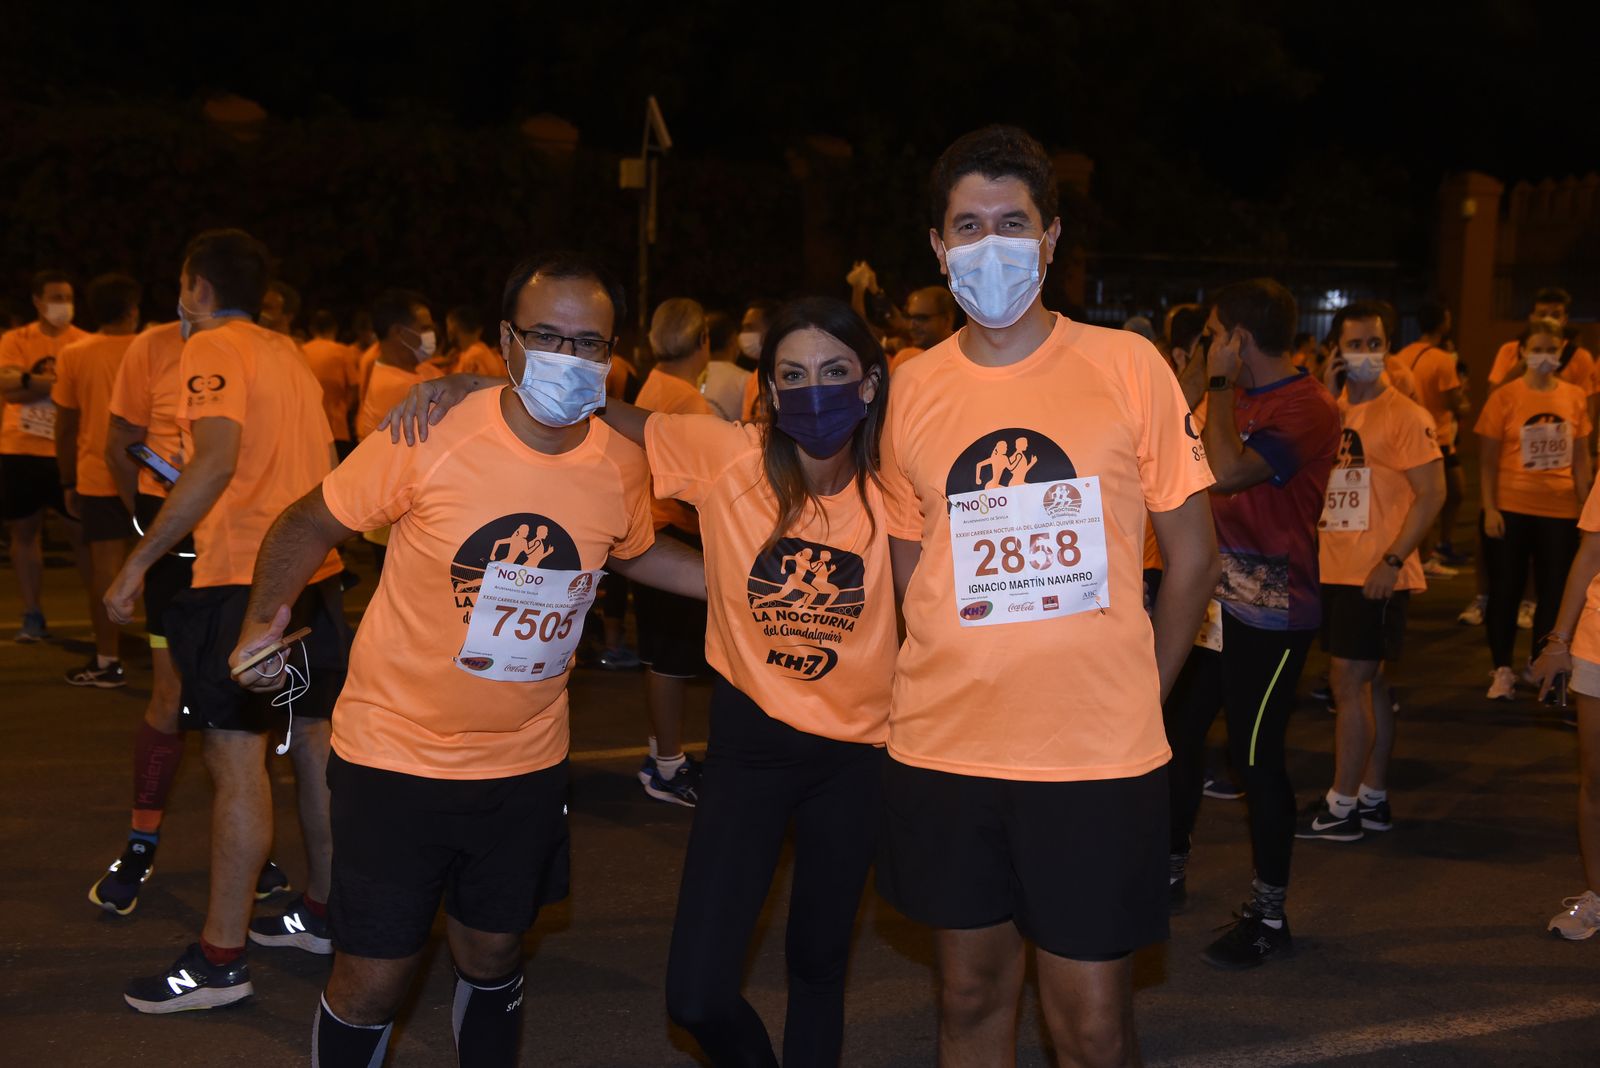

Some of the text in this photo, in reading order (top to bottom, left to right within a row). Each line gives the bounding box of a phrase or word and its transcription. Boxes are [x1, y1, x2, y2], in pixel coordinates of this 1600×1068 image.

[1327, 490, 1360, 510] 578
[970, 529, 993, 537] CARRERA
[972, 529, 1082, 577] 2858
[968, 571, 1093, 594] IGNACIO MARTÍN NAVARRO
[454, 596, 475, 608] LA
[497, 596, 520, 604] CARRERA
[519, 599, 546, 608] NOCTURNA
[492, 604, 578, 643] 7505
[752, 610, 856, 632] LA NOCTURNA
[763, 624, 844, 645] del Guadalquivir
